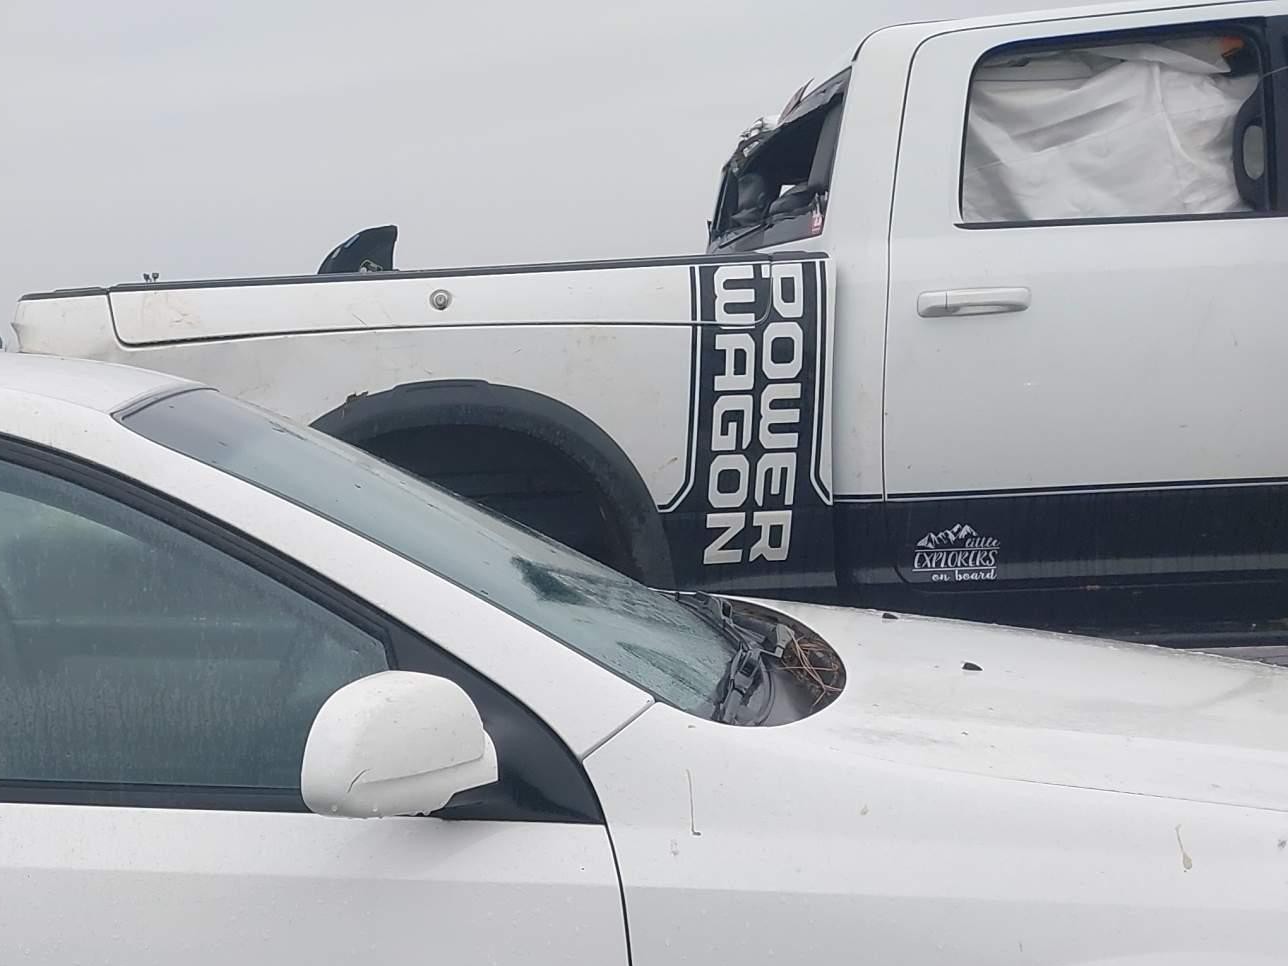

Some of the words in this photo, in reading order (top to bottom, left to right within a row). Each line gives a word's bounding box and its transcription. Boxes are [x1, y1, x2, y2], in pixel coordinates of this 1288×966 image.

[703, 264, 755, 565] WAGON
[749, 263, 804, 562] POWER
[914, 550, 998, 569] EXPLORERS
[932, 573, 951, 582] on
[955, 568, 998, 582] board
